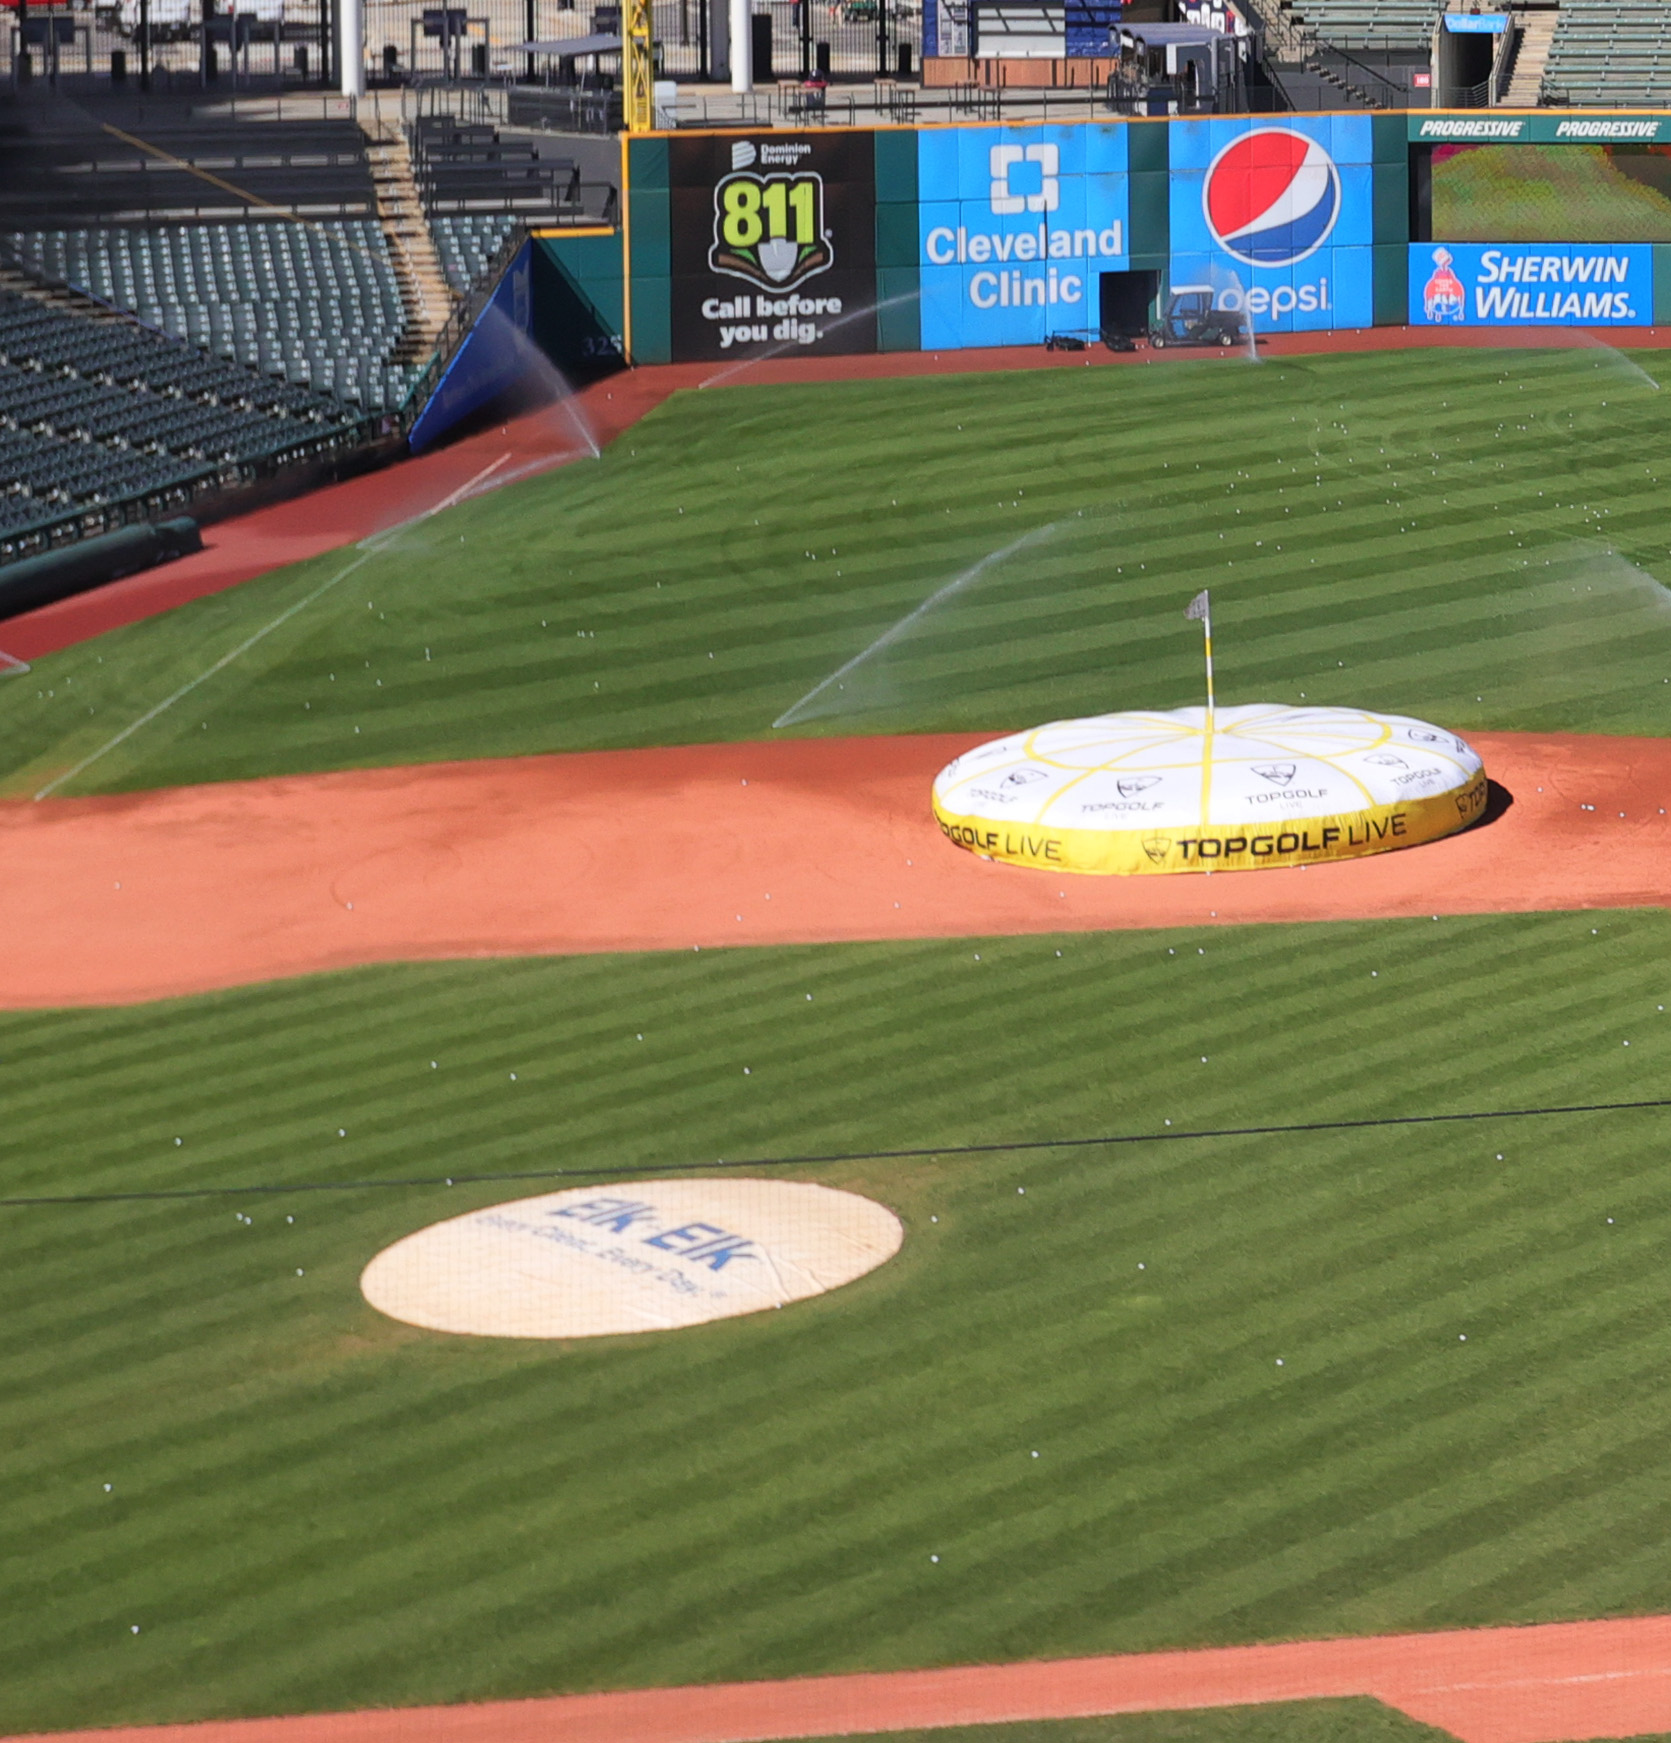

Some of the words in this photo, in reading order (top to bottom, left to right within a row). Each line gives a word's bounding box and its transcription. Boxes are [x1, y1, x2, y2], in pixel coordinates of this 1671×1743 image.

[1420, 120, 1523, 138] PROGRESSIVE
[1555, 120, 1659, 138] PROGRESSIVE
[760, 143, 811, 155] Dominion
[760, 155, 799, 165] Energy
[723, 180, 815, 248] 811
[925, 219, 1124, 265] Cleveland
[1477, 251, 1629, 283] SHERWIN
[969, 267, 1083, 309] Clinic
[1217, 277, 1328, 322] pepsi
[1475, 286, 1630, 319] WILLIAMS
[701, 296, 751, 319] Call
[756, 294, 843, 317] before
[581, 334, 623, 357] 325
[719, 324, 769, 349] you
[773, 318, 824, 344] dig.
[1080, 801, 1165, 814] TOPGOLF
[1244, 787, 1329, 806] TOPGOLF
[1004, 833, 1063, 863] LIVE
[1175, 826, 1341, 860] TOPGOLF
[1347, 812, 1408, 846] LIVE
